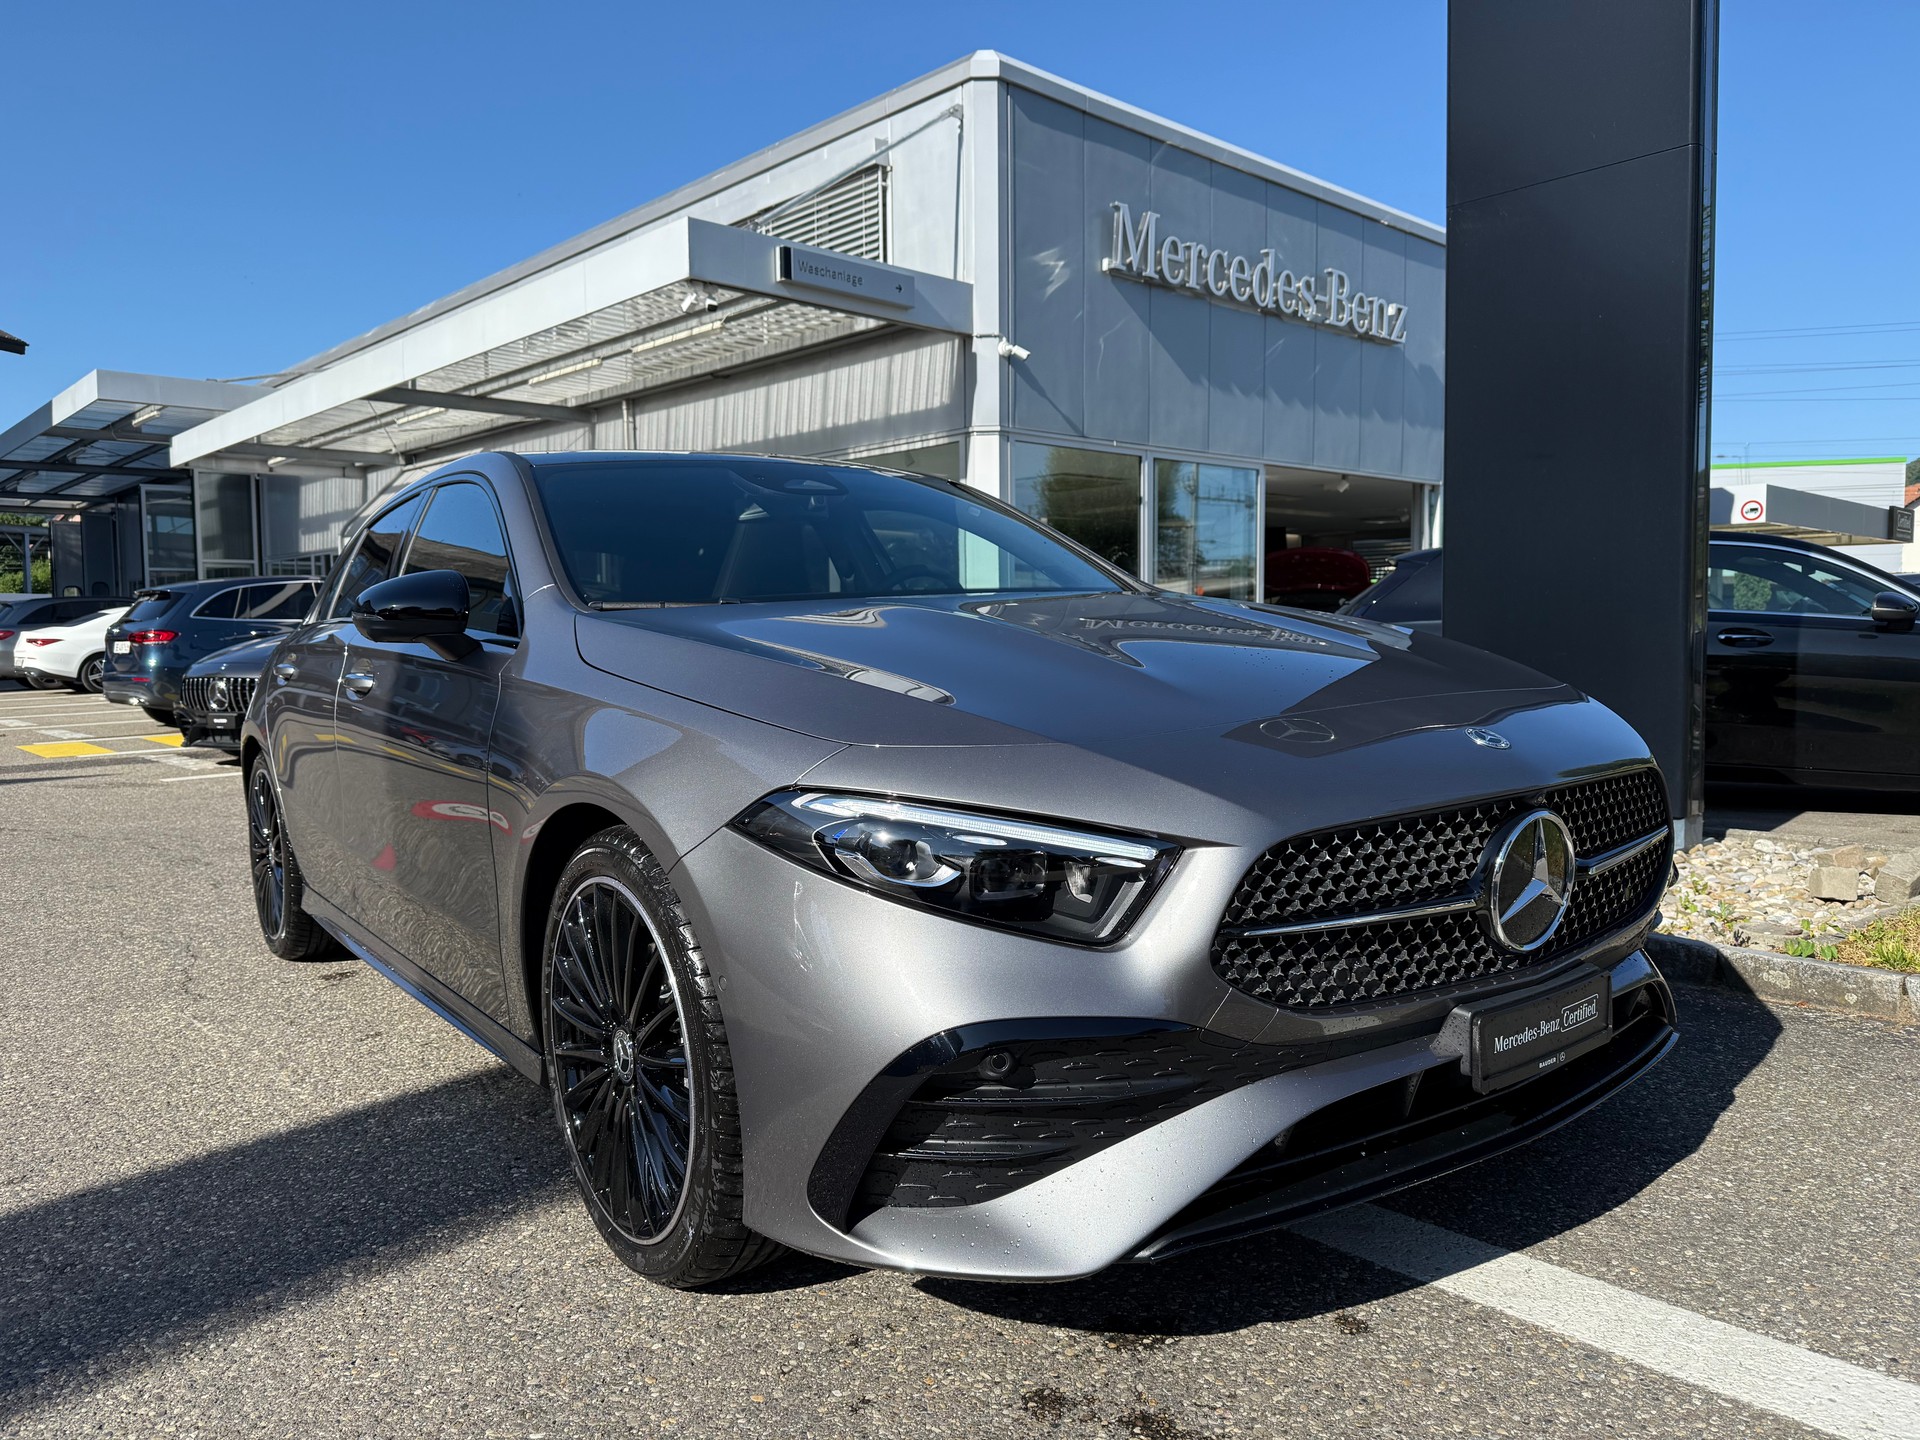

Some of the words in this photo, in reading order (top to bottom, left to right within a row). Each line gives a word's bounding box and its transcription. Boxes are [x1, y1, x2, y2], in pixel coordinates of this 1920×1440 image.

[798, 260, 864, 287] Waschanlage
[1109, 201, 1408, 343] Mercedes-Benz
[1494, 1018, 1561, 1054] Mercedes-Benz
[1563, 999, 1597, 1027] Certified
[1539, 1057, 1557, 1069] BAUDER
